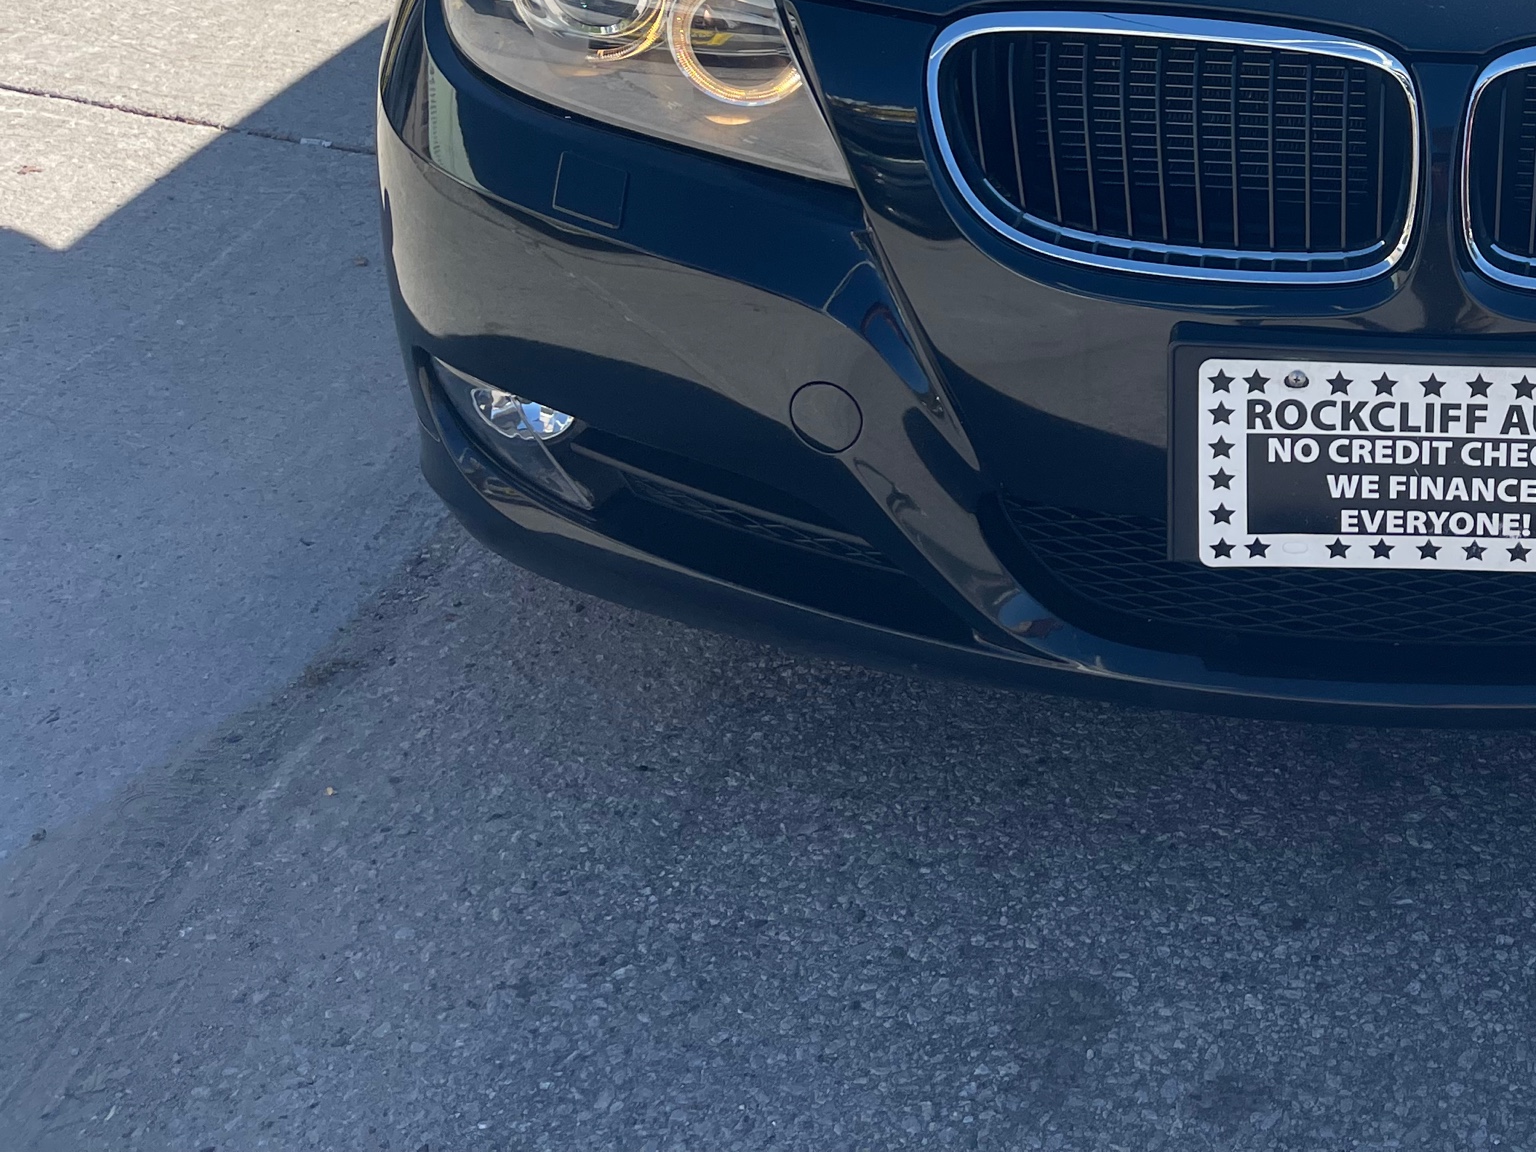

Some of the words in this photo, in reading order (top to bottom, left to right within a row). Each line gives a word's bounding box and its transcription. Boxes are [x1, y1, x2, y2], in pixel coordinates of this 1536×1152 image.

[1245, 398, 1489, 434] ROCKCLIFF
[1267, 437, 1320, 464] NO
[1327, 439, 1454, 467] CREDIT
[1326, 474, 1381, 500] WE
[1339, 509, 1532, 538] EVERYONE!
